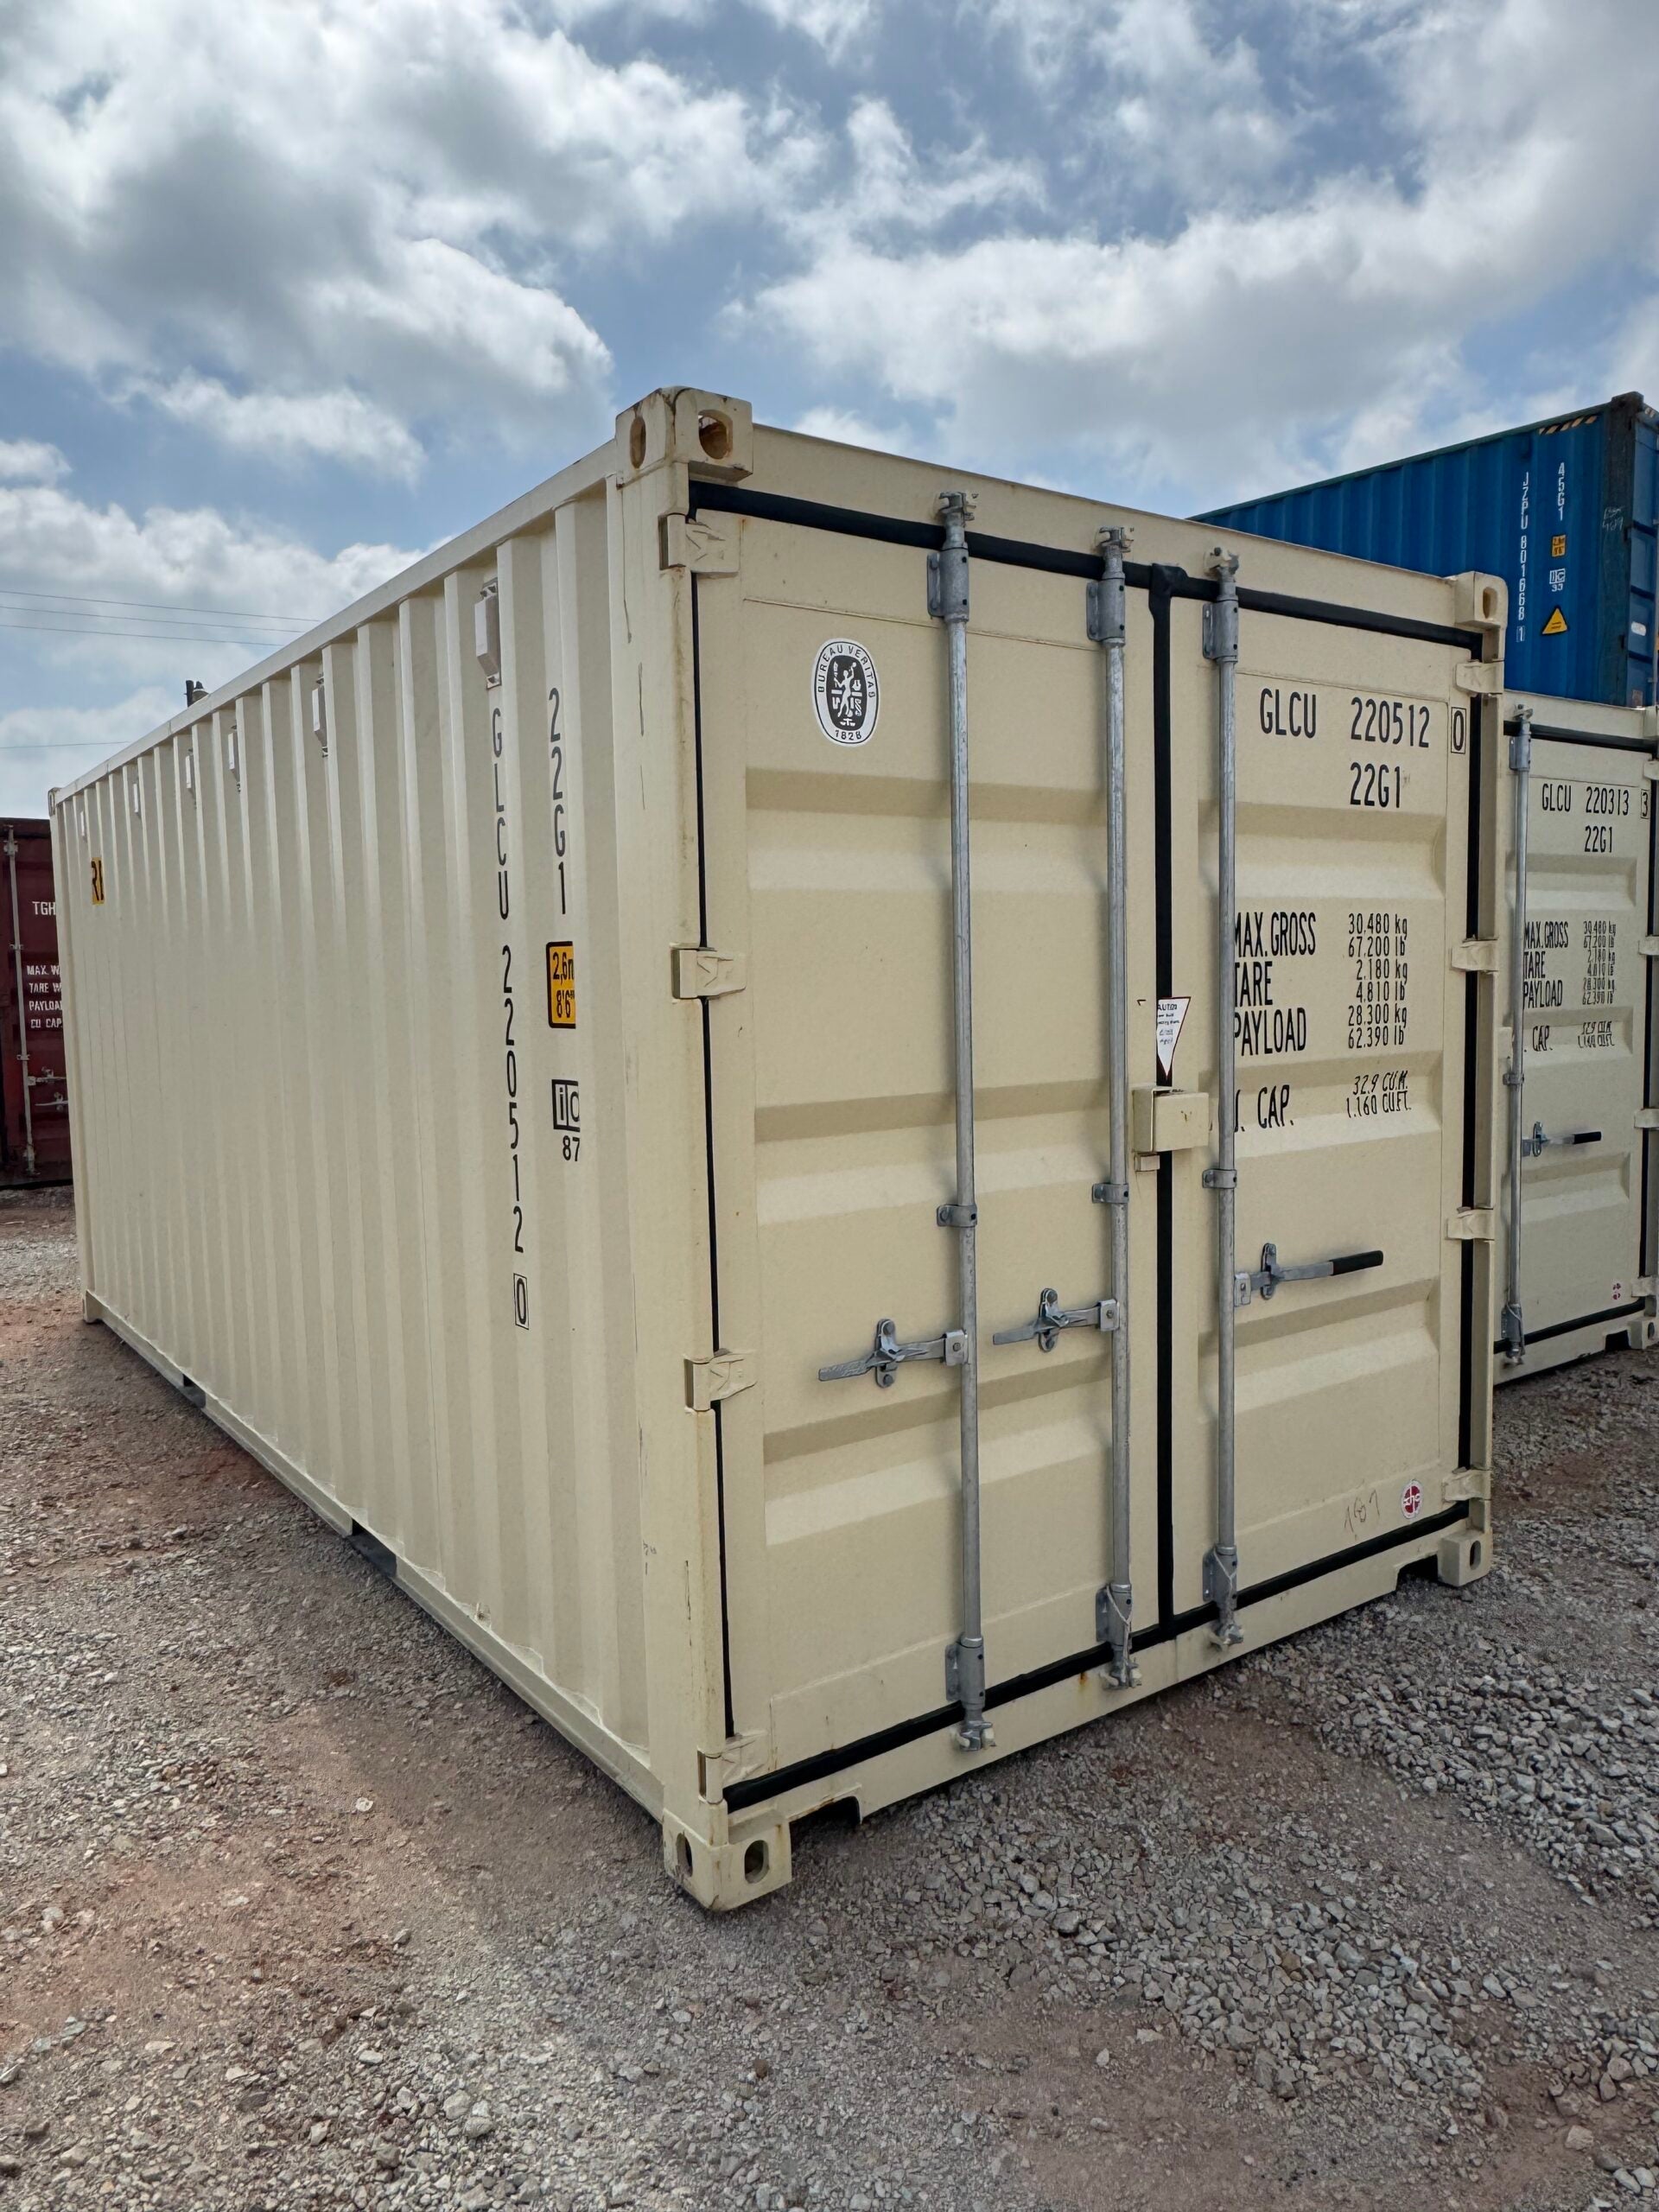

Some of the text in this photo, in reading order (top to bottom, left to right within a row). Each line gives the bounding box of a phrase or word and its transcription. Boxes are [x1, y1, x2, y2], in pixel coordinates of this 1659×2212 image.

[817, 645, 875, 698] BUREAU VERITAS
[1260, 688, 1465, 751] GLCU 220512 0
[835, 729, 862, 741] 1828
[1350, 762, 1401, 808] 22G1
[549, 688, 566, 914] 22G1
[1541, 783, 1649, 817] GLCU 220313 3
[1584, 825, 1612, 853] 22G1
[1348, 913, 1389, 935] 30.480
[1395, 913, 1408, 940] kg
[1348, 936, 1406, 957] 67.200 lb
[1356, 958, 1389, 980] 2.180
[1395, 959, 1408, 985] kg
[1523, 951, 1546, 979] TARE
[29, 983, 49, 993] TARE
[1356, 981, 1405, 1002] 4.810 lb
[1523, 980, 1563, 1009] PAYLOAD
[493, 708, 527, 1325] GLCU 220512 0
[1235, 1003, 1408, 1056] PAYLOAD 28.300 kg
[1348, 1026, 1404, 1049] 62.390 lb
[1352, 1074, 1380, 1096] 32.9
[1257, 1084, 1294, 1128] CAP.
[1346, 1094, 1377, 1118] 1.160
[563, 1135, 580, 1162] 87
